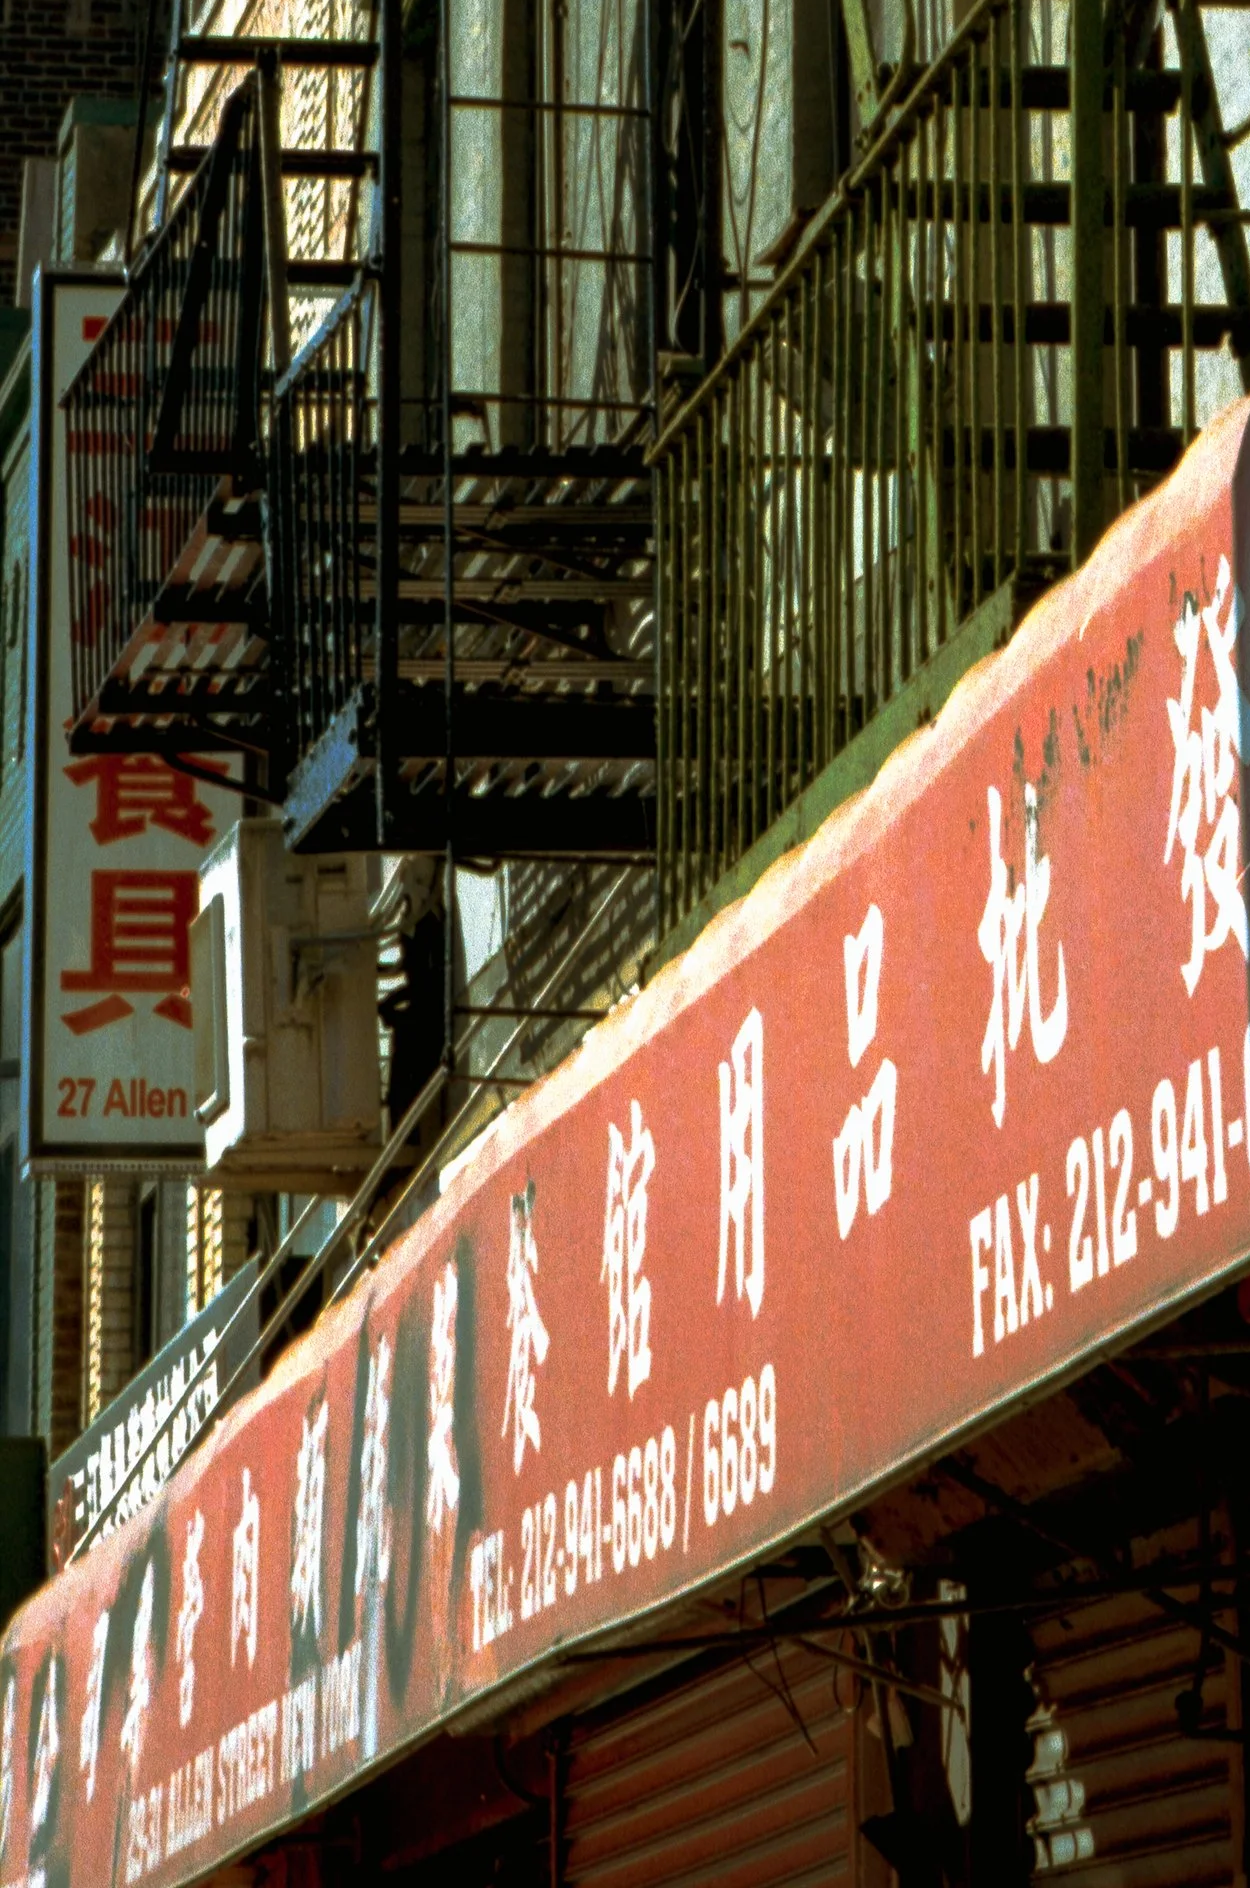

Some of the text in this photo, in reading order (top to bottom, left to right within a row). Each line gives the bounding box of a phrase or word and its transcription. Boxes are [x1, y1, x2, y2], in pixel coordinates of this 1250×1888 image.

[58, 1079, 187, 1117] 27 Allen
[969, 1172, 1054, 1358] FAX:
[470, 1528, 511, 1653] TEL:
[703, 1363, 776, 1527] 6689
[165, 1744, 214, 1860] ALLEN
[217, 1698, 279, 1826] STREET
[280, 1672, 317, 1786] NEW
